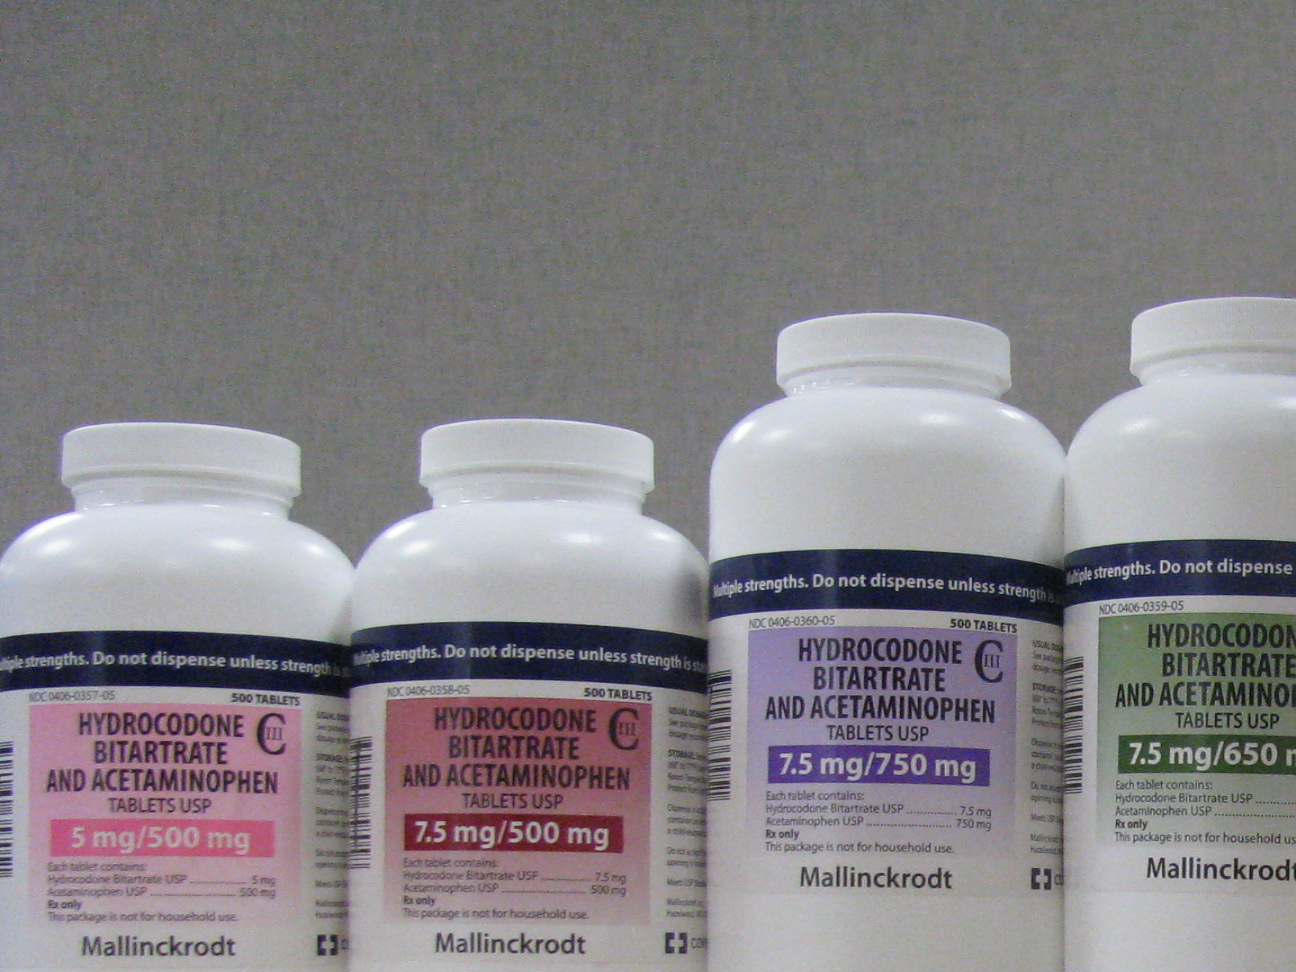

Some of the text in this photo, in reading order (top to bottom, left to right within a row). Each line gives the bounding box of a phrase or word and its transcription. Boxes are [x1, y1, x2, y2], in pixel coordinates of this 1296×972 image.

[1094, 561, 1155, 581] strengths.
[1159, 560, 1181, 574] Do
[1185, 561, 1213, 574] not
[1217, 559, 1292, 577] dispense
[745, 573, 1047, 601] strengths. Do not dispense unless strength
[1099, 601, 1184, 615] NDC 0406-0359-05
[749, 616, 835, 629] NDC 0406-0360-05
[950, 618, 1017, 633] 500 TABLETS
[380, 644, 681, 668] strengths. Do not dispense unless strength
[799, 638, 962, 664] HYDROCODONE
[25, 652, 89, 669] strengths.
[93, 652, 116, 665] Do
[119, 652, 147, 665] not
[151, 652, 225, 668] dispense
[230, 656, 277, 670] unless
[282, 659, 332, 675] strength
[1162, 653, 1296, 678] BITARTRATE
[813, 667, 945, 691] BITARTRATE
[232, 694, 300, 706] 500 TABLETS
[584, 688, 652, 700] 500 TABLETS
[1116, 684, 1153, 708] AND
[434, 707, 596, 733] HYDROCODONE
[766, 696, 995, 723] AND ACETAMINOPHEN
[1175, 712, 1279, 729] TABLETS USP
[79, 713, 244, 737] HYDROCODONE
[826, 725, 929, 741] TABLETS USP
[94, 742, 227, 764] BITARTRATE
[449, 736, 579, 759] BITARTRATE
[1129, 742, 1162, 765] 7.5
[1169, 742, 1278, 771] mg/650
[403, 765, 629, 789] AND ACETAMINOPHEN
[779, 753, 976, 782] 7.5 mg/750 mg
[46, 770, 277, 794] AND ACETAMINOPHEN
[1116, 780, 1213, 791] Each tablet contains:
[109, 798, 211, 813] TABLETS USP
[462, 794, 563, 809] TABLETS USP
[71, 827, 250, 853] 5 mg/500 mg
[415, 820, 610, 849] 7.5 mg/500 mg
[1115, 832, 1130, 842] This
[1132, 833, 1172, 845] package
[1174, 833, 1181, 842] is
[1183, 834, 1201, 843] not
[1203, 833, 1221, 843] for
[1223, 833, 1281, 844] household
[800, 866, 952, 889] Mallinckrodt
[82, 936, 235, 956] Mallinckrodt
[435, 933, 586, 954] Mallinckrodt
